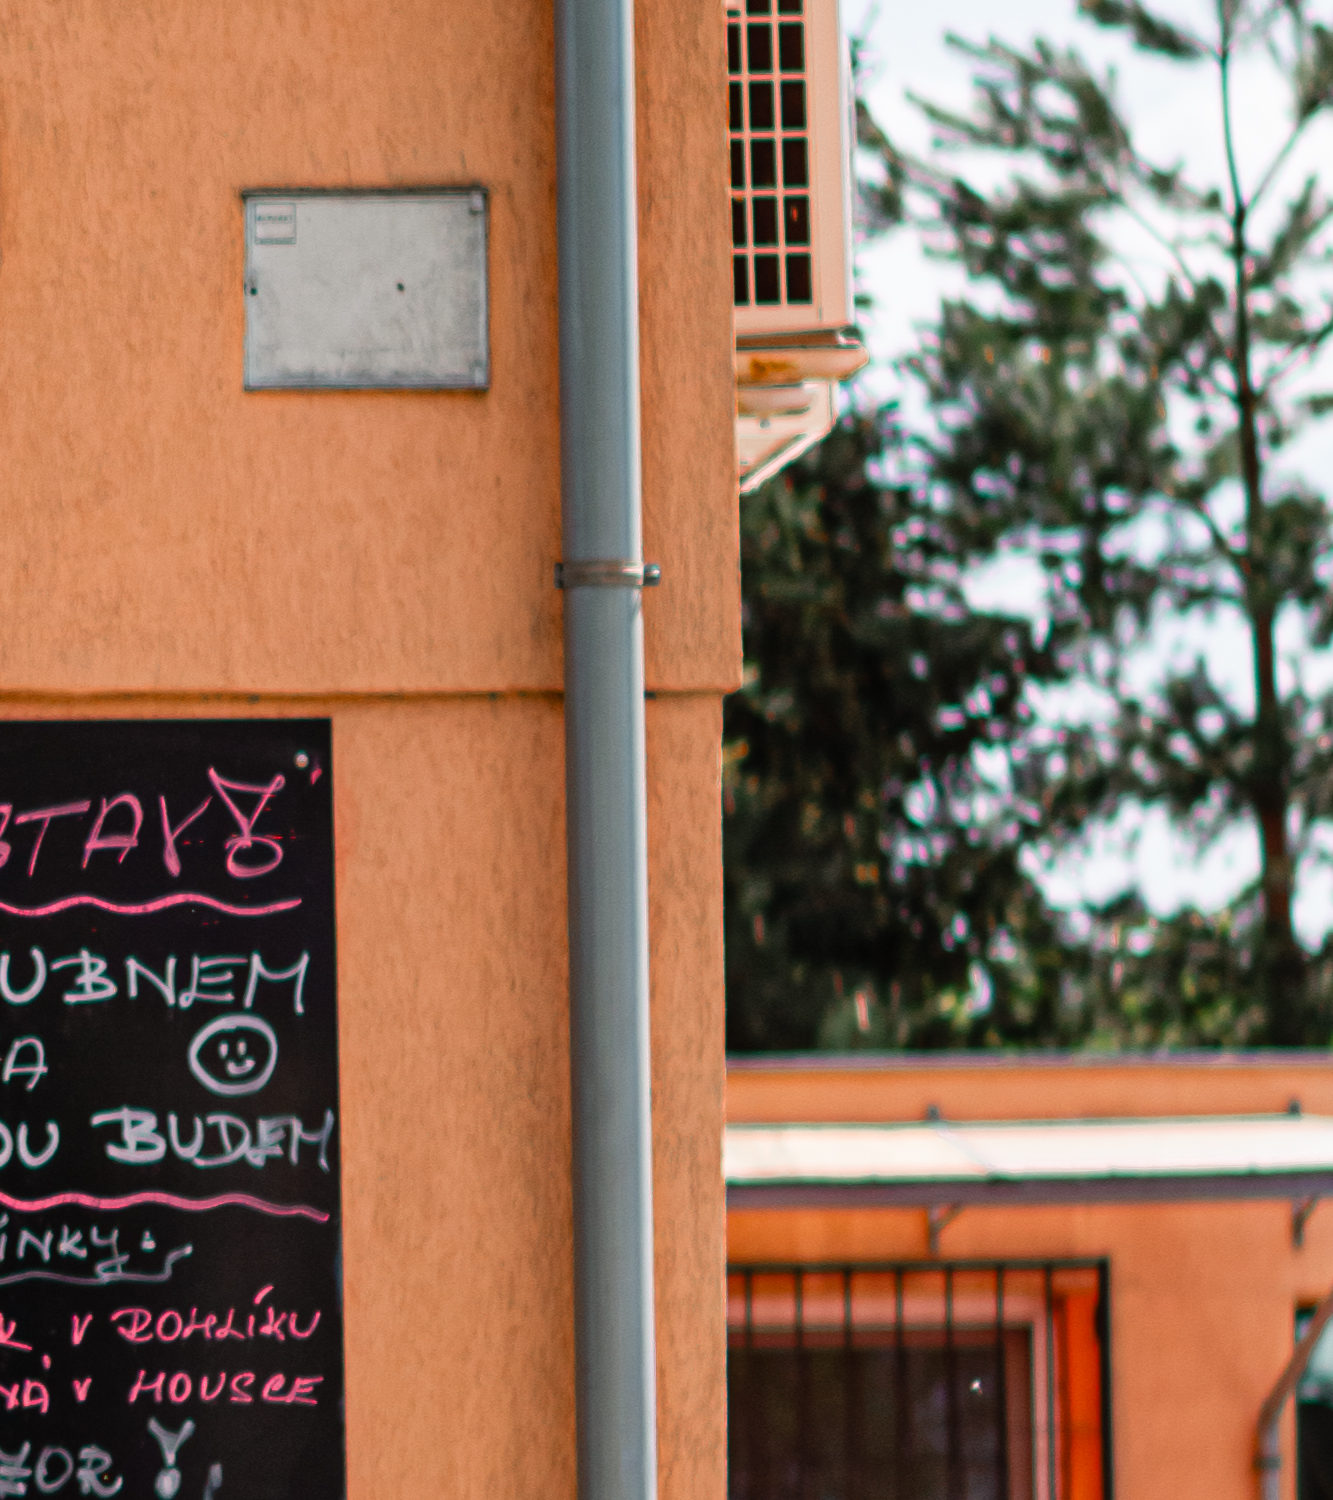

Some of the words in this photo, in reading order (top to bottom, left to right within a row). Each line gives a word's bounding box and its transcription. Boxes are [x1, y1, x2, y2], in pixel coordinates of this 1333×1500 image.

[90, 1107, 334, 1171] BUDEM
[111, 1285, 322, 1343] ROHLÍKU
[130, 1371, 325, 1405] HOUSCE
